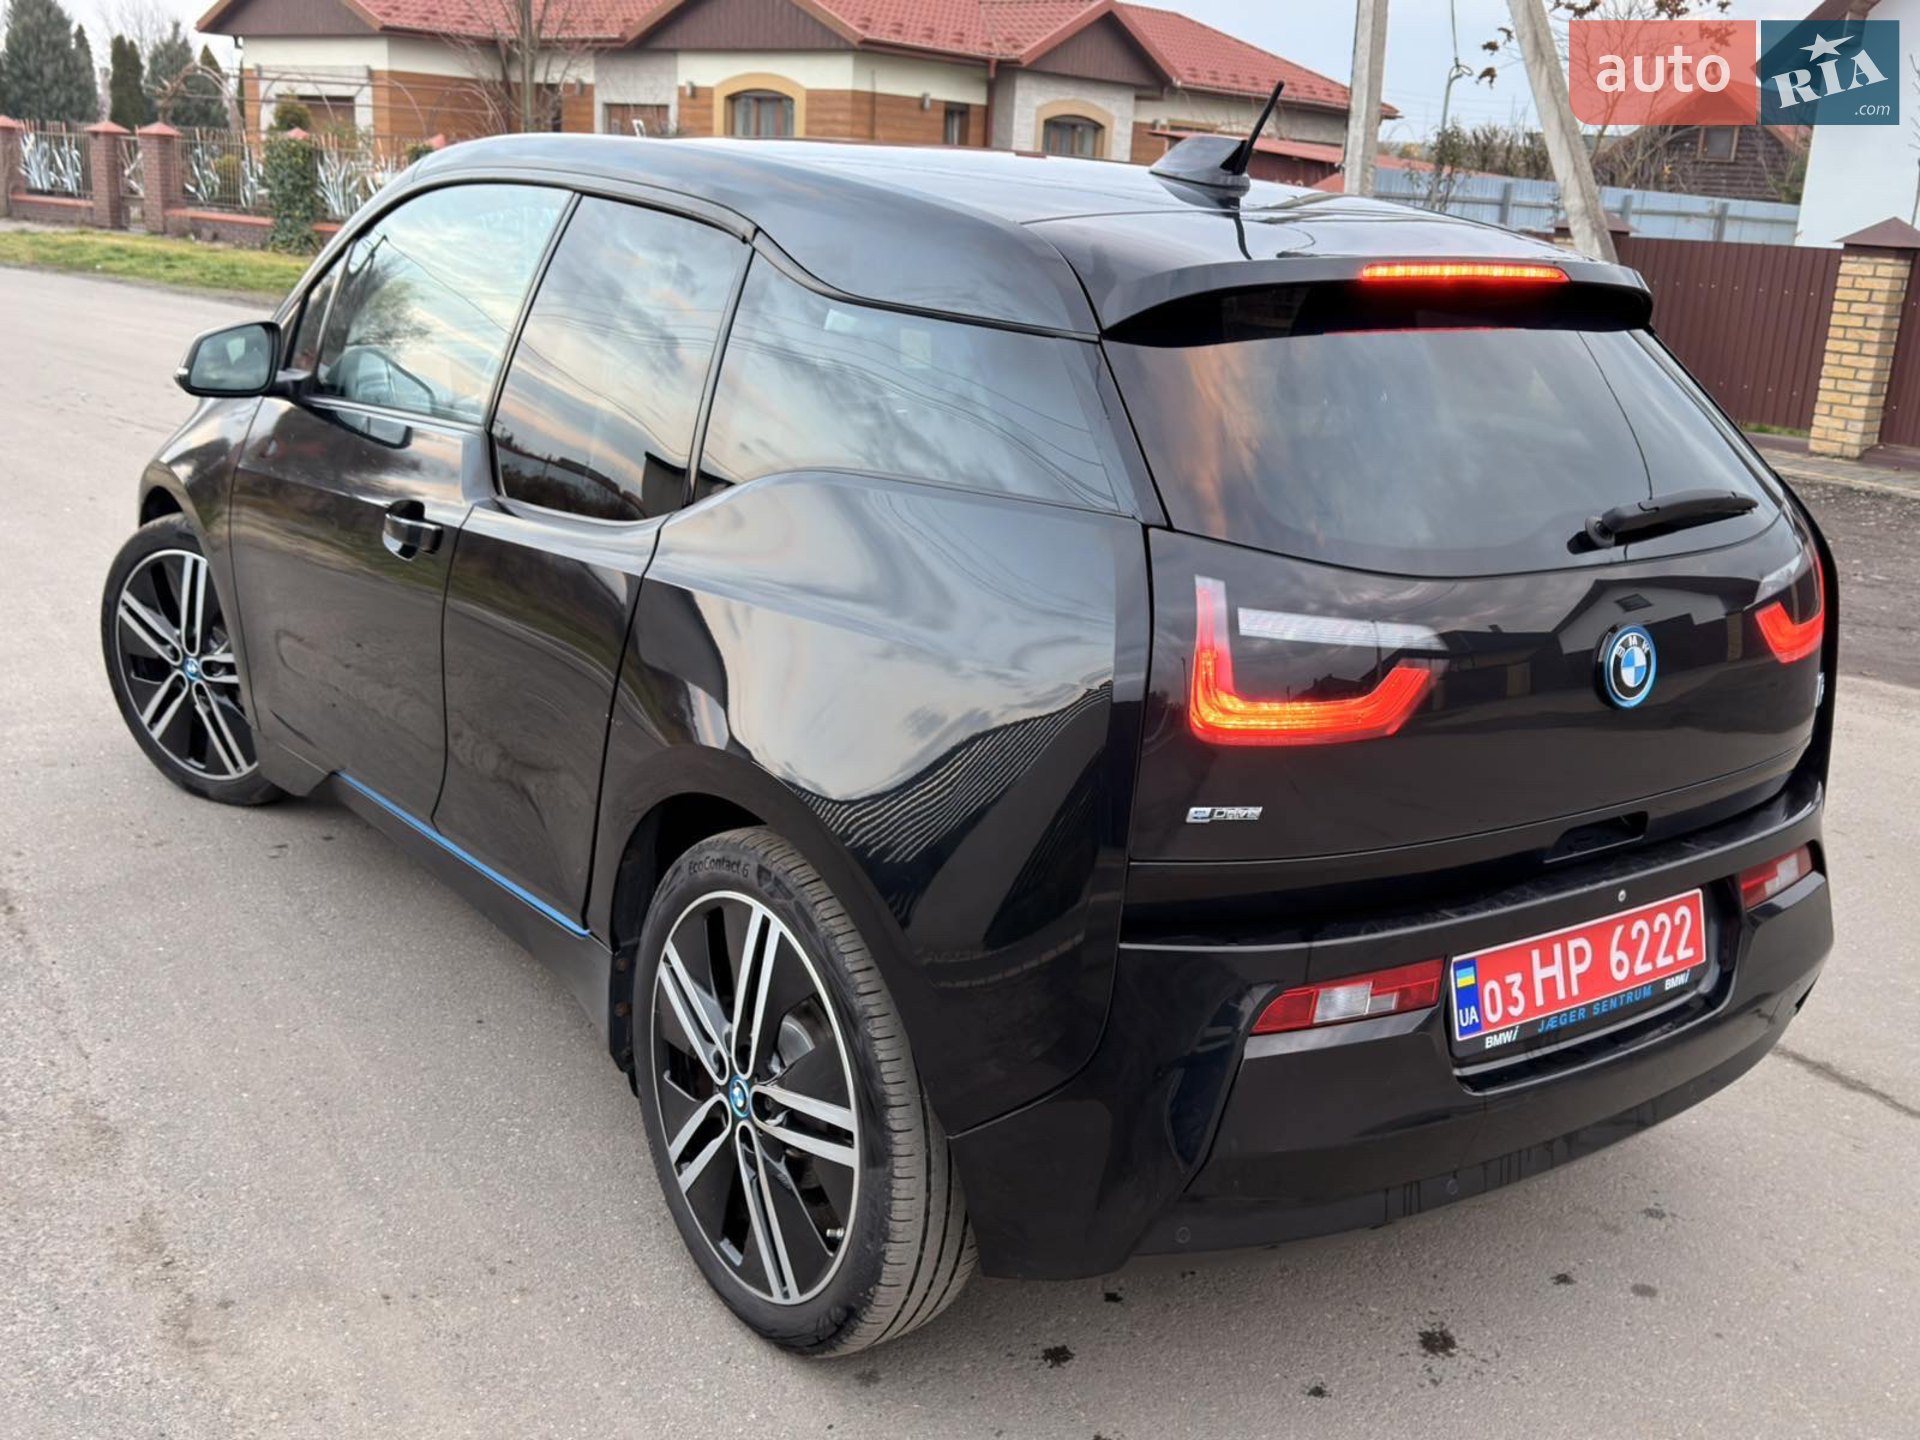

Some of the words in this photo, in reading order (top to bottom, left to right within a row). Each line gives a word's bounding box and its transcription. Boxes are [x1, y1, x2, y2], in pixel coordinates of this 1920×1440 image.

[1483, 972, 1525, 1024] 03
[1531, 937, 1593, 1006] HP
[1610, 905, 1695, 982] 6222
[1459, 1008, 1479, 1027] UA
[1537, 1006, 1586, 1033] JÆGER
[1593, 985, 1652, 1017] SENTRUM
